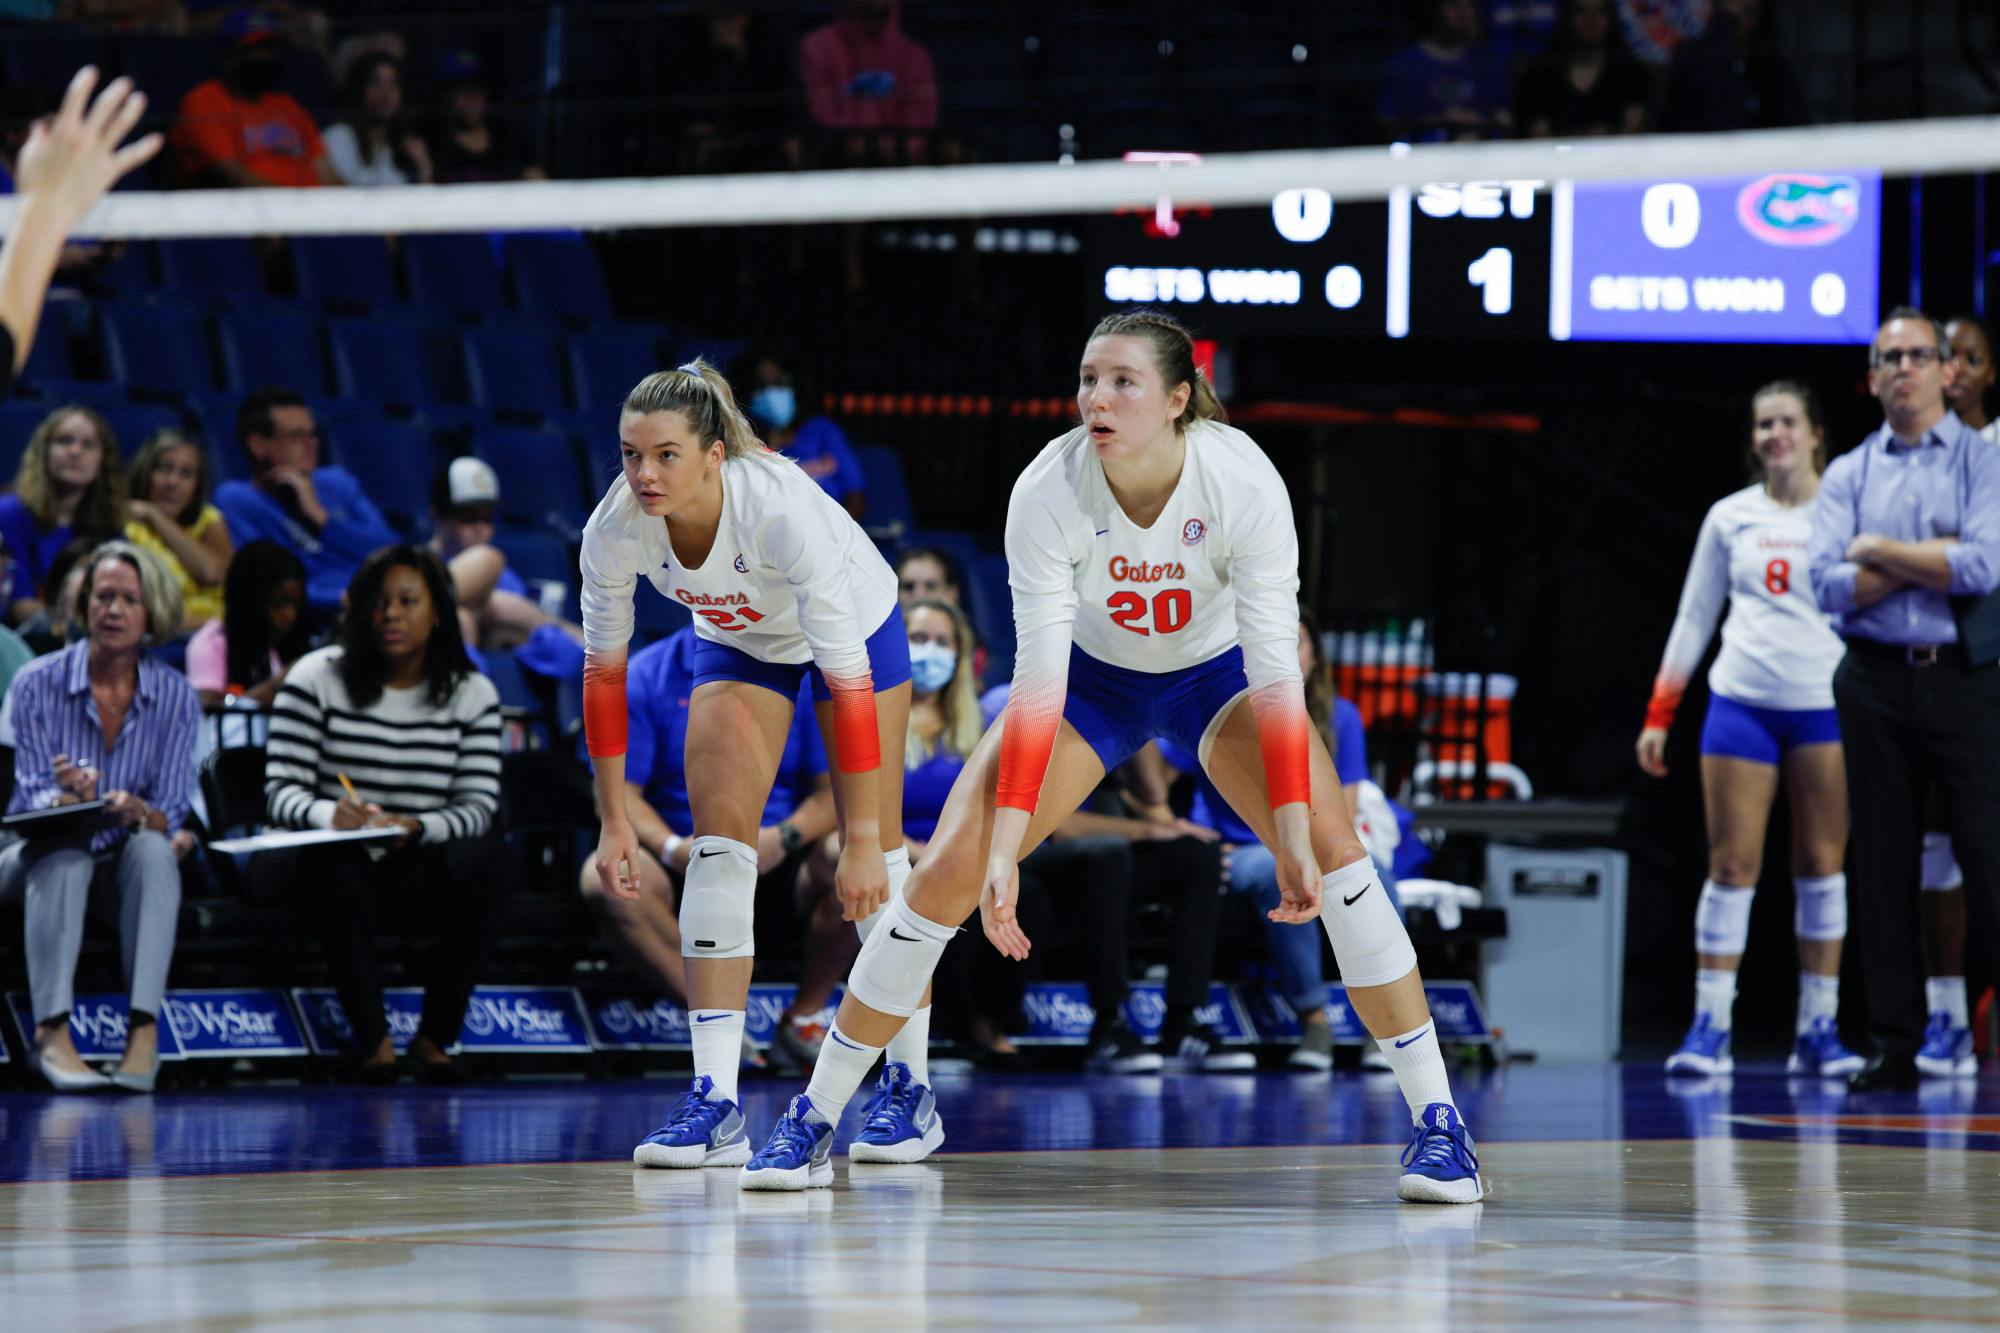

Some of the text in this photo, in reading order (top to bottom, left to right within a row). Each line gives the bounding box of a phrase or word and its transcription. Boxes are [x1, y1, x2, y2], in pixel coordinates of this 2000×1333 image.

[1417, 179, 1545, 219] SET
[1641, 183, 1700, 248] 0
[1105, 266, 1205, 302] SETS
[1325, 265, 1362, 308] 0
[1468, 247, 1512, 314] 1
[1590, 274, 1688, 311] SETS
[1810, 272, 1846, 316] 0
[1109, 555, 1186, 583] Gators
[1765, 558, 1791, 595] 8
[675, 588, 751, 606] Gators
[1106, 588, 1192, 636] 20
[695, 606, 767, 631] 21
[190, 1000, 278, 1042] VyStar
[482, 998, 565, 1039] VyStar
